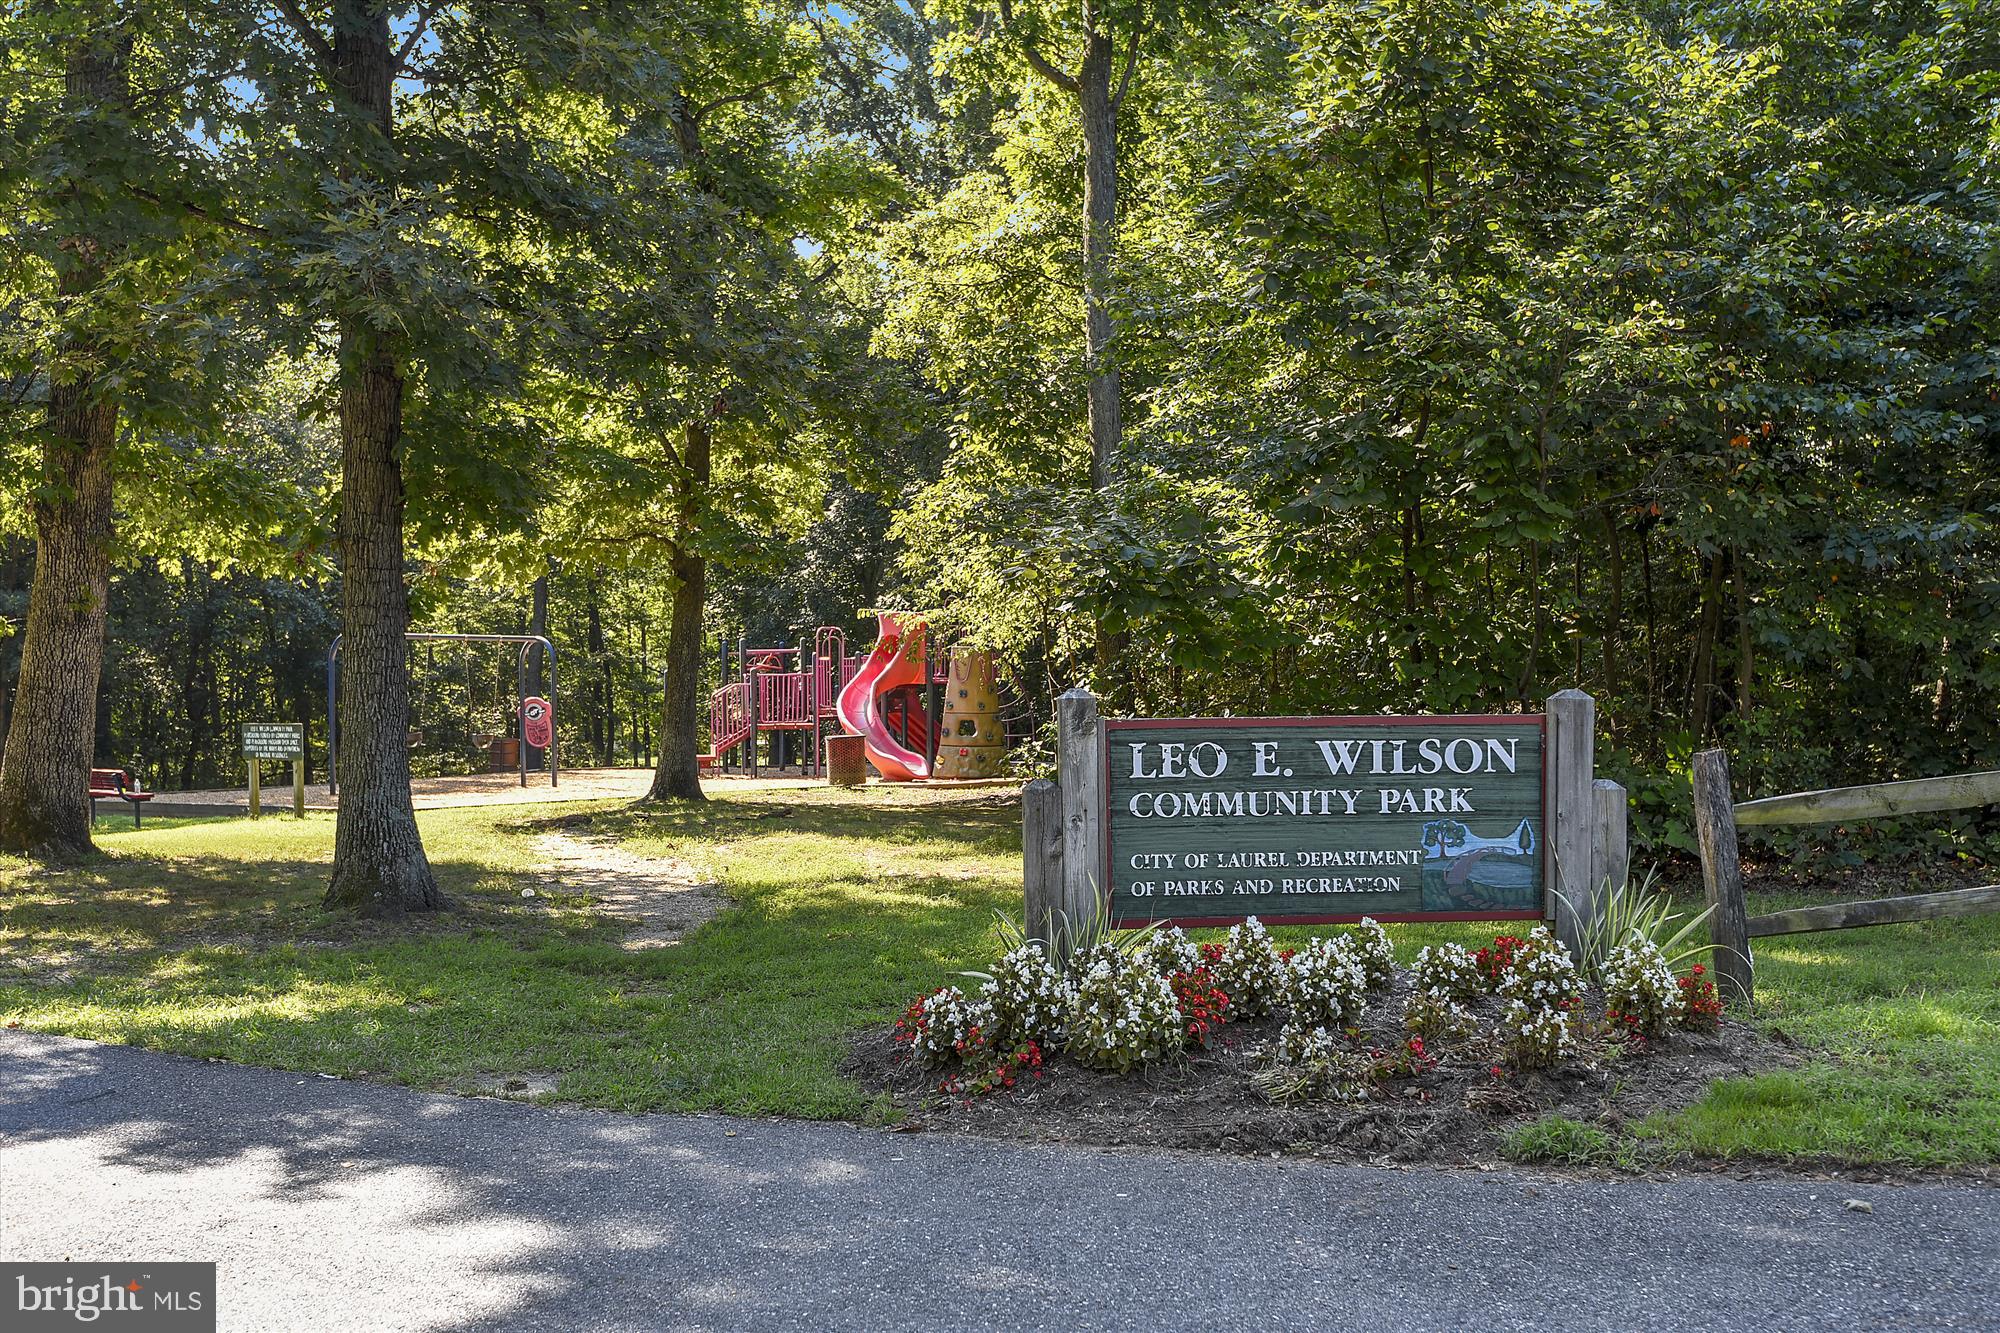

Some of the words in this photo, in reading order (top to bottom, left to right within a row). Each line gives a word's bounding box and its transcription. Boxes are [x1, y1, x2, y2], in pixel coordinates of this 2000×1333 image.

[1128, 742, 1228, 779] LEO
[1252, 741, 1294, 778] E.
[1315, 738, 1519, 776] WILSON
[1129, 789, 1363, 818] COMMUNITY
[1379, 788, 1475, 815] PARK
[1130, 853, 1175, 871] CITY
[1184, 853, 1209, 869] OF
[1217, 851, 1290, 868] LAUREL
[1297, 849, 1423, 868] DEPARTMENT
[1131, 880, 1155, 897] OF
[1163, 879, 1224, 896] PARKS
[1232, 879, 1273, 895] AND
[1281, 877, 1401, 895] RECREATION
